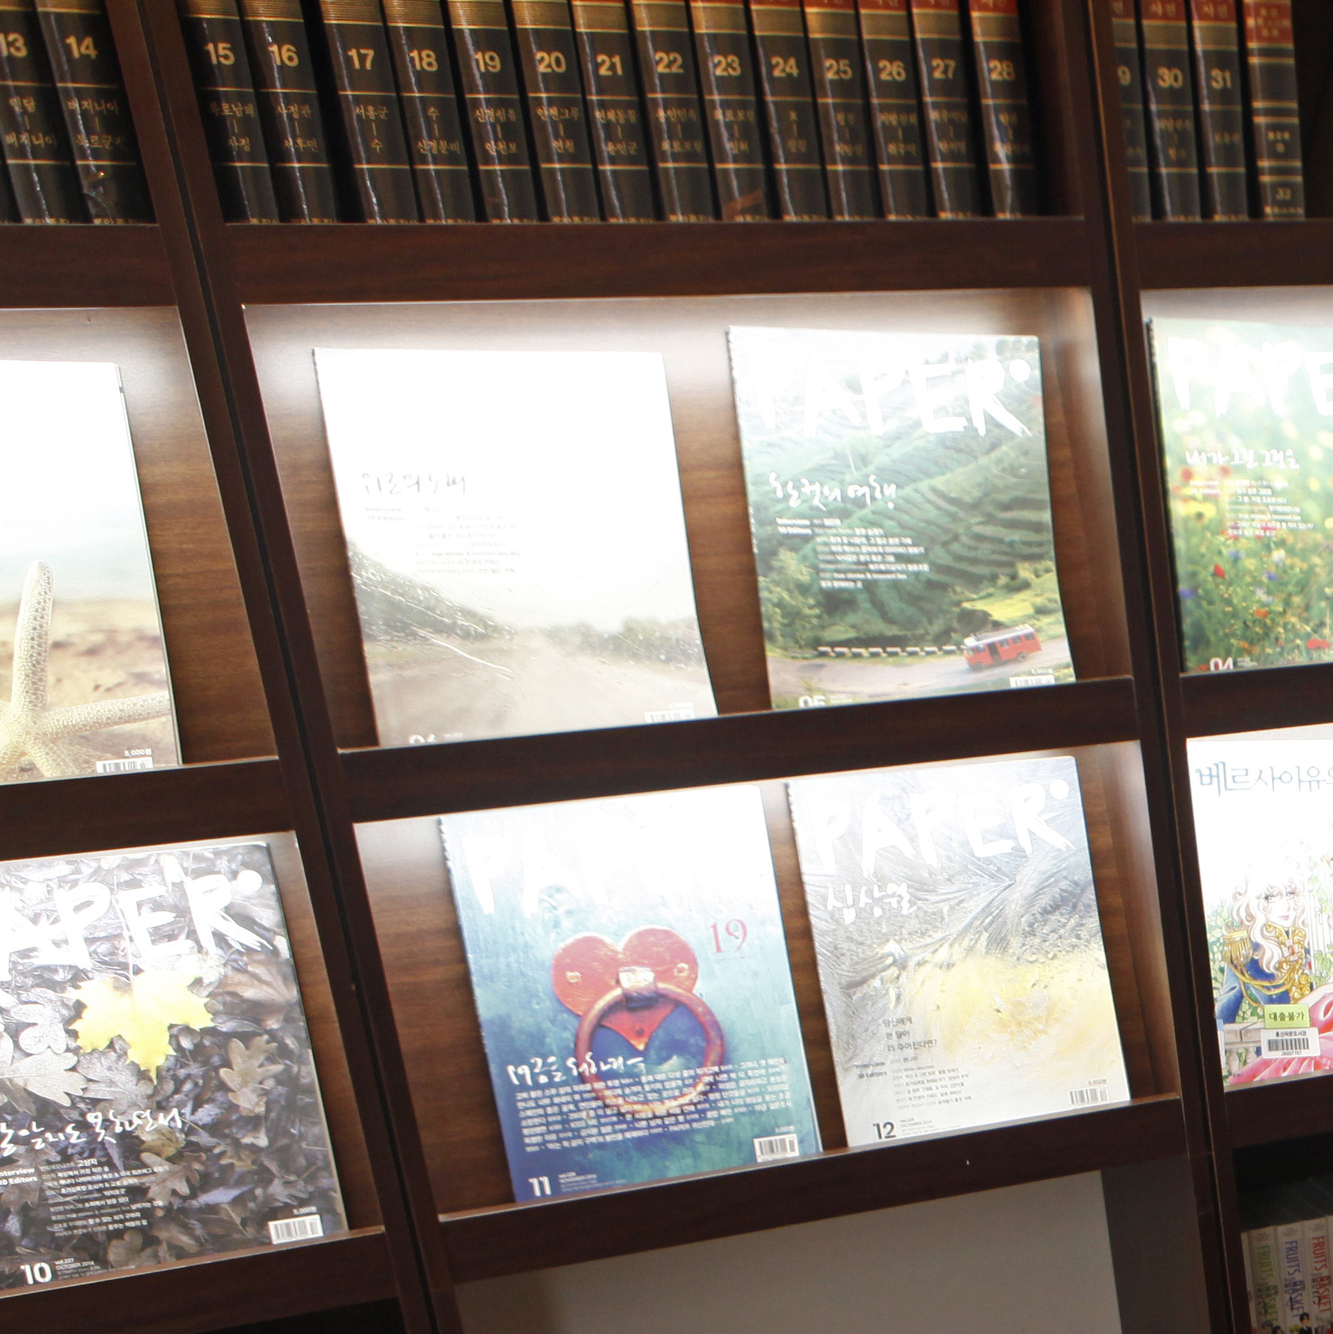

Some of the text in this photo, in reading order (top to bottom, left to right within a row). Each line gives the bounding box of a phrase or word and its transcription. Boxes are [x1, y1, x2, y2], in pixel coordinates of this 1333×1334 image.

[65, 35, 98, 60] 14
[204, 42, 236, 66] 15
[268, 43, 299, 67] 16
[347, 48, 375, 70] 17
[409, 49, 438, 72] 18
[474, 51, 501, 73] 19
[535, 51, 567, 74] 20
[597, 54, 623, 76] 21
[655, 51, 685, 74] 22
[713, 54, 741, 77] 23
[771, 56, 800, 78] 24
[824, 58, 852, 80] 25
[878, 59, 906, 82] 26
[931, 57, 957, 80] 27
[988, 60, 1015, 81] 28
[1157, 67, 1183, 88] 30
[1211, 68, 1233, 89] 31
[808, 780, 1076, 878] PAPER
[708, 918, 749, 954] 19
[1268, 1011, 1306, 1022] 대출불가
[873, 1121, 897, 1140] 12
[529, 1177, 552, 1197] 11
[1257, 1246, 1273, 1282] FRUITS
[1285, 1240, 1301, 1276] FRUITS
[1312, 1236, 1328, 1272] FRUITS
[20, 1262, 53, 1285] 10
